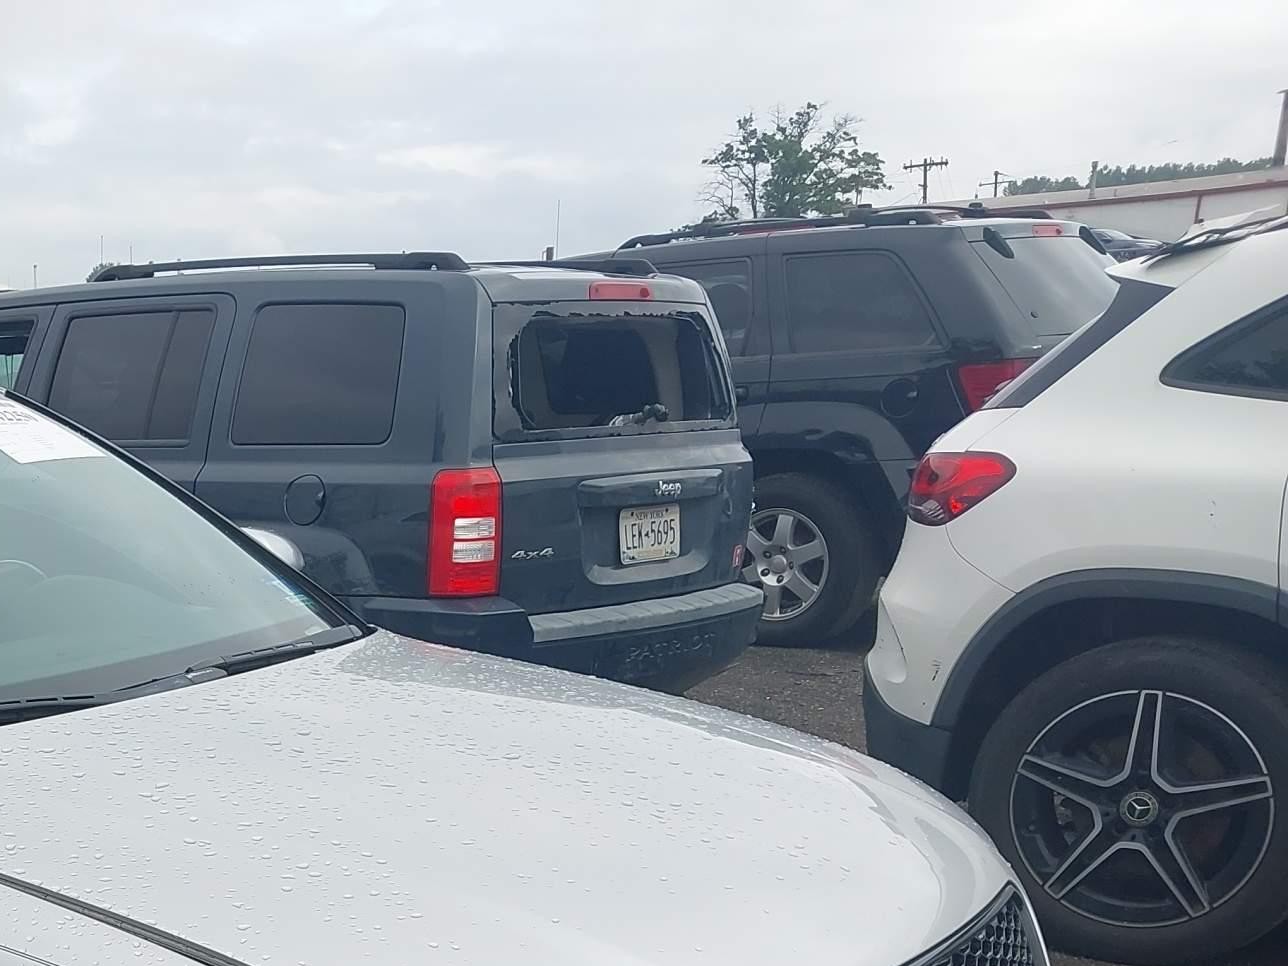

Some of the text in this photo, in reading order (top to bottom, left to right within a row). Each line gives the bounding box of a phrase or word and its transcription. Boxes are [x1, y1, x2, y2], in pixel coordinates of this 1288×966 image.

[655, 480, 681, 499] Jeep
[635, 511, 649, 521] NEW
[624, 518, 676, 551] LEK 5695
[511, 547, 554, 560] 4x4
[625, 633, 716, 662] PATRIOT
